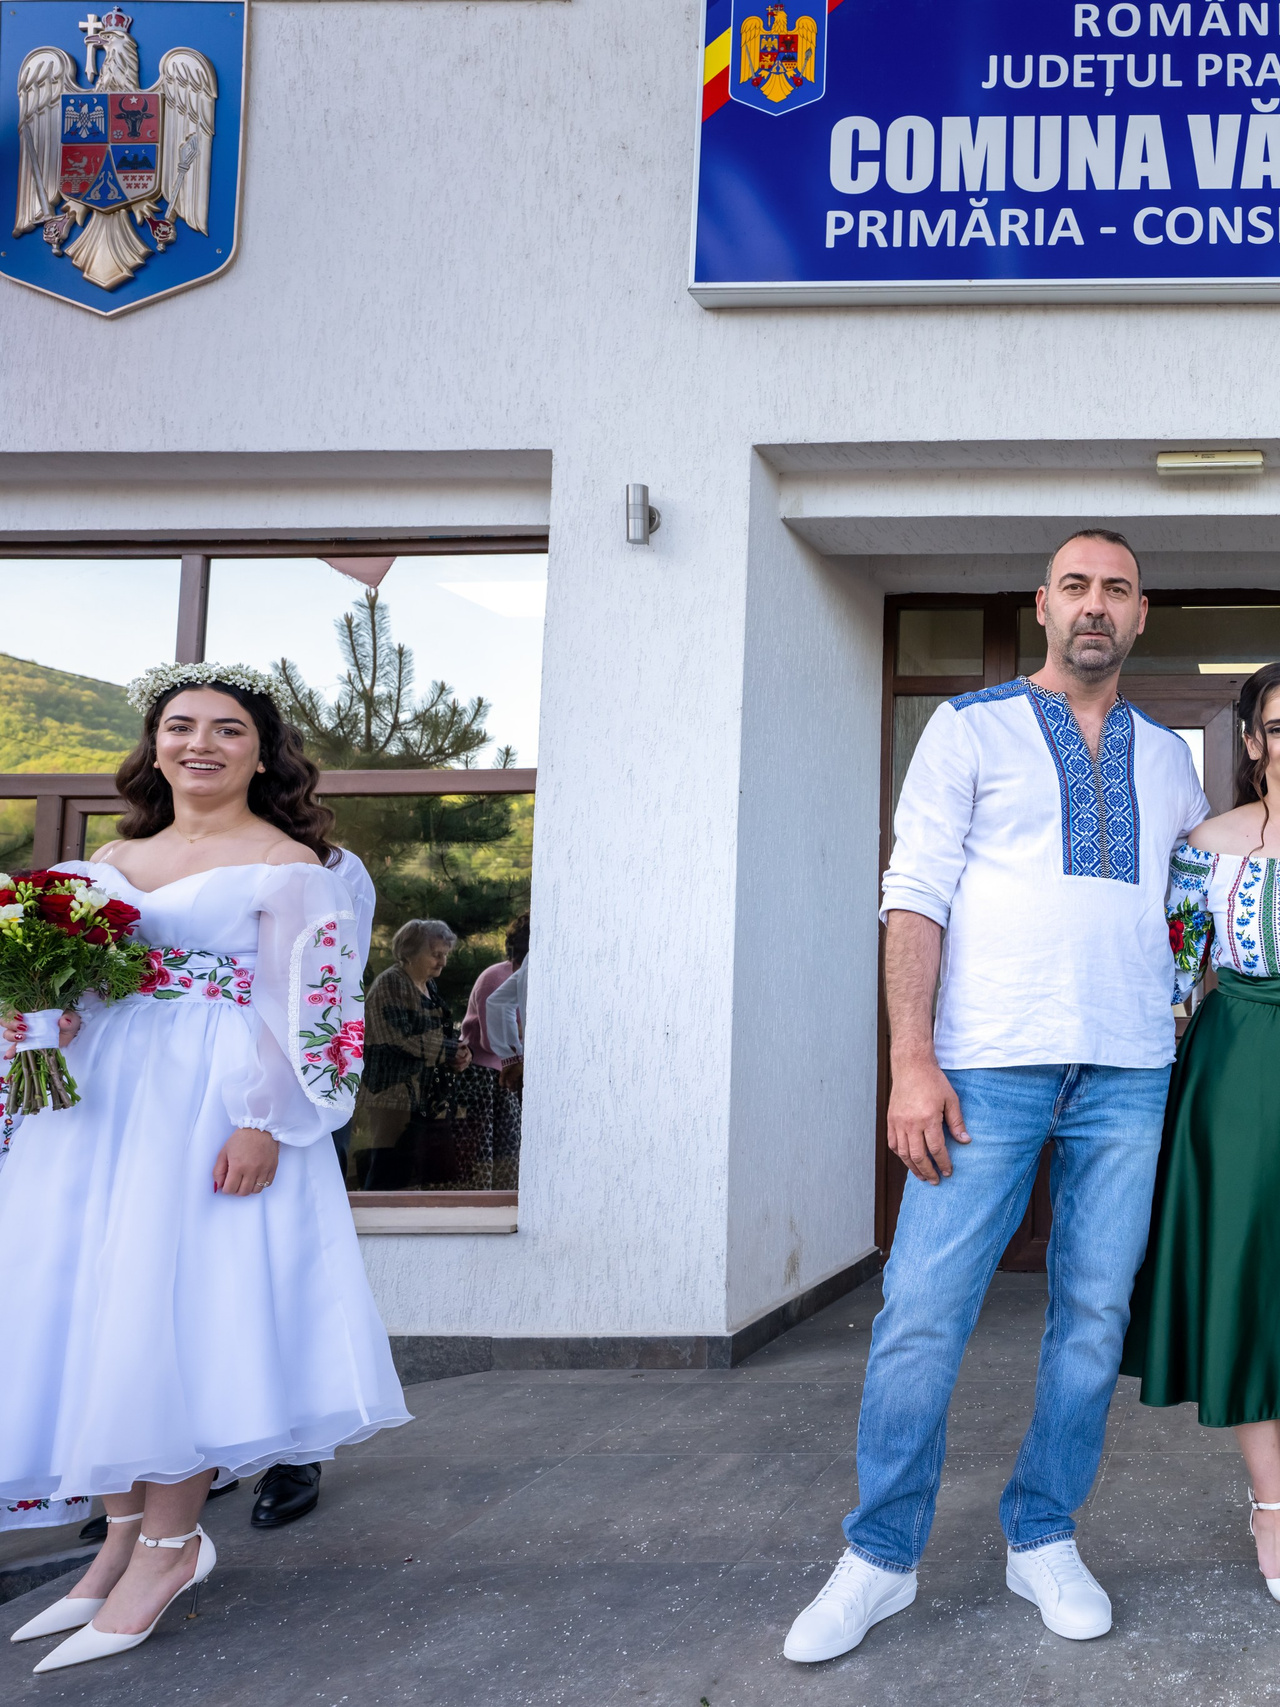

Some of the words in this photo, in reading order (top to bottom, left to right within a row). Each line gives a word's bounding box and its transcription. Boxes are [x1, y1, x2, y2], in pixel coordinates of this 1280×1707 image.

[981, 53, 1183, 97] JUDEȚUL
[829, 114, 1172, 195] COMUNA
[825, 197, 1085, 249] PRIMĂRIA
[1099, 226, 1117, 234] -
